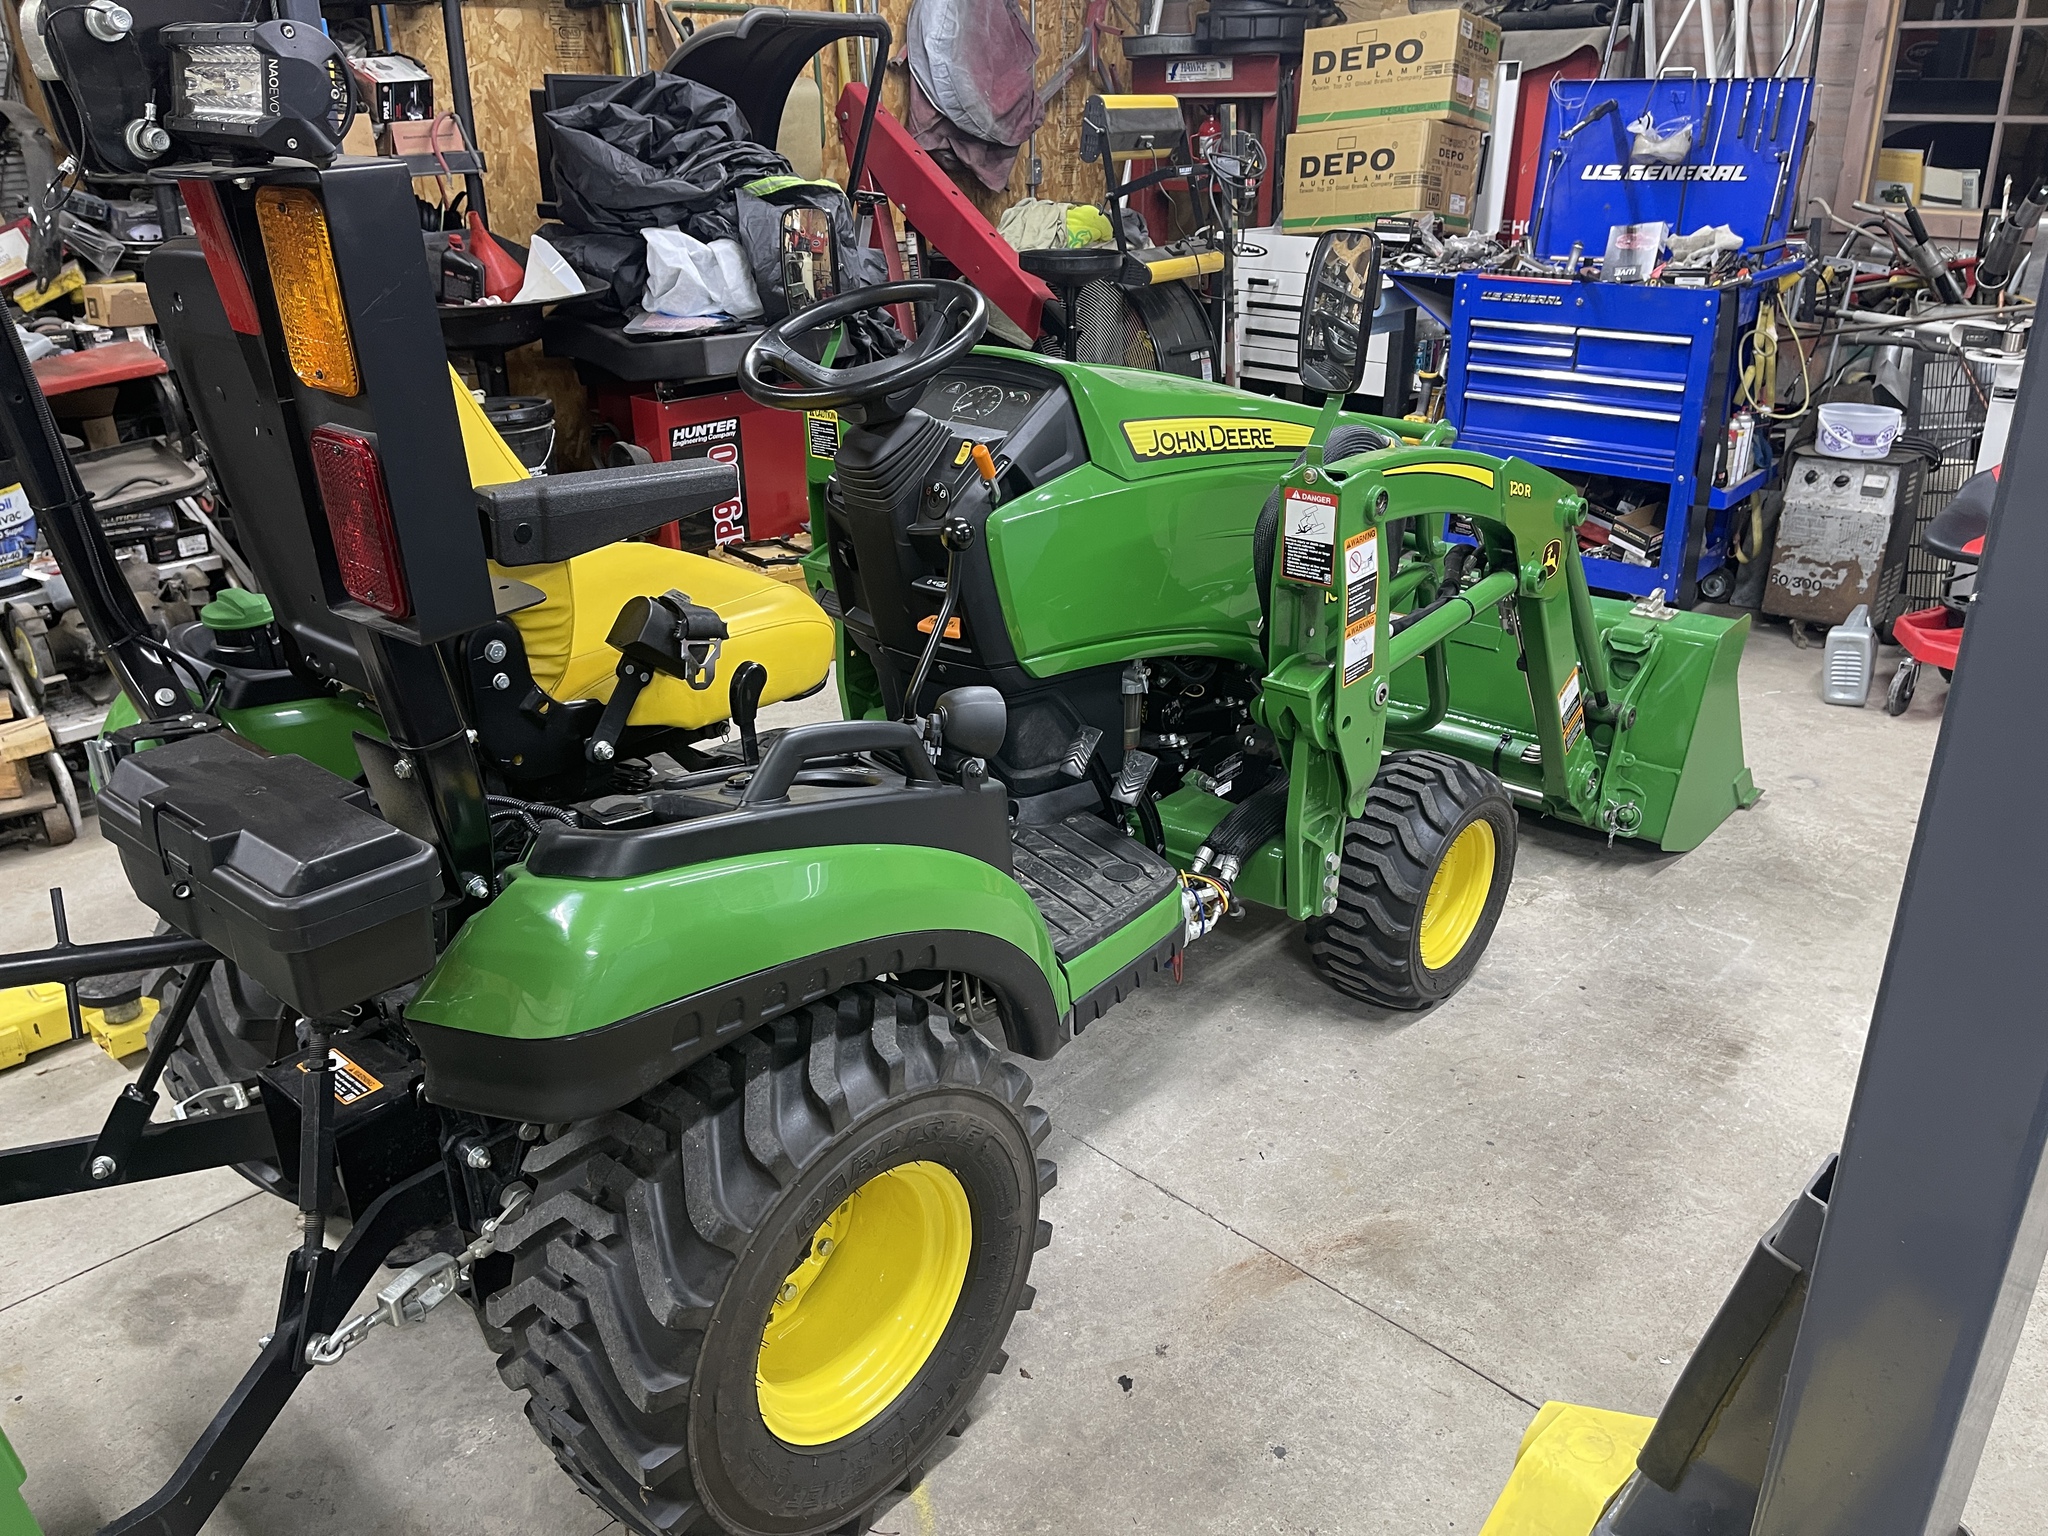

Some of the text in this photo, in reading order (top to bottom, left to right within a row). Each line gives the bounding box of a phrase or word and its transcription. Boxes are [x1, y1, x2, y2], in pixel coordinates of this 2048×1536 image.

[1467, 39, 1489, 55] DEPO
[1311, 38, 1424, 76] DEPO
[1311, 74, 1353, 86] AUTO
[1375, 65, 1422, 78] LAMP
[268, 58, 280, 114] NAOEVO
[1300, 148, 1396, 179] DEPO
[1439, 148, 1464, 161] DEPO
[1300, 178, 1335, 188] AUTO
[1354, 173, 1394, 183] LAMP
[1627, 164, 1748, 181] GENERAL
[1502, 293, 1562, 305] GENERAL
[673, 419, 737, 441] HUNTER
[673, 430, 737, 447] Engineering Company
[1147, 425, 1274, 453] JOHN DEERE
[1510, 480, 1531, 498] 120R
[1302, 493, 1331, 504] DANGER
[1351, 530, 1376, 547] WARNING
[1351, 617, 1375, 635] WARNING
[797, 1117, 985, 1240] CARLISLE
